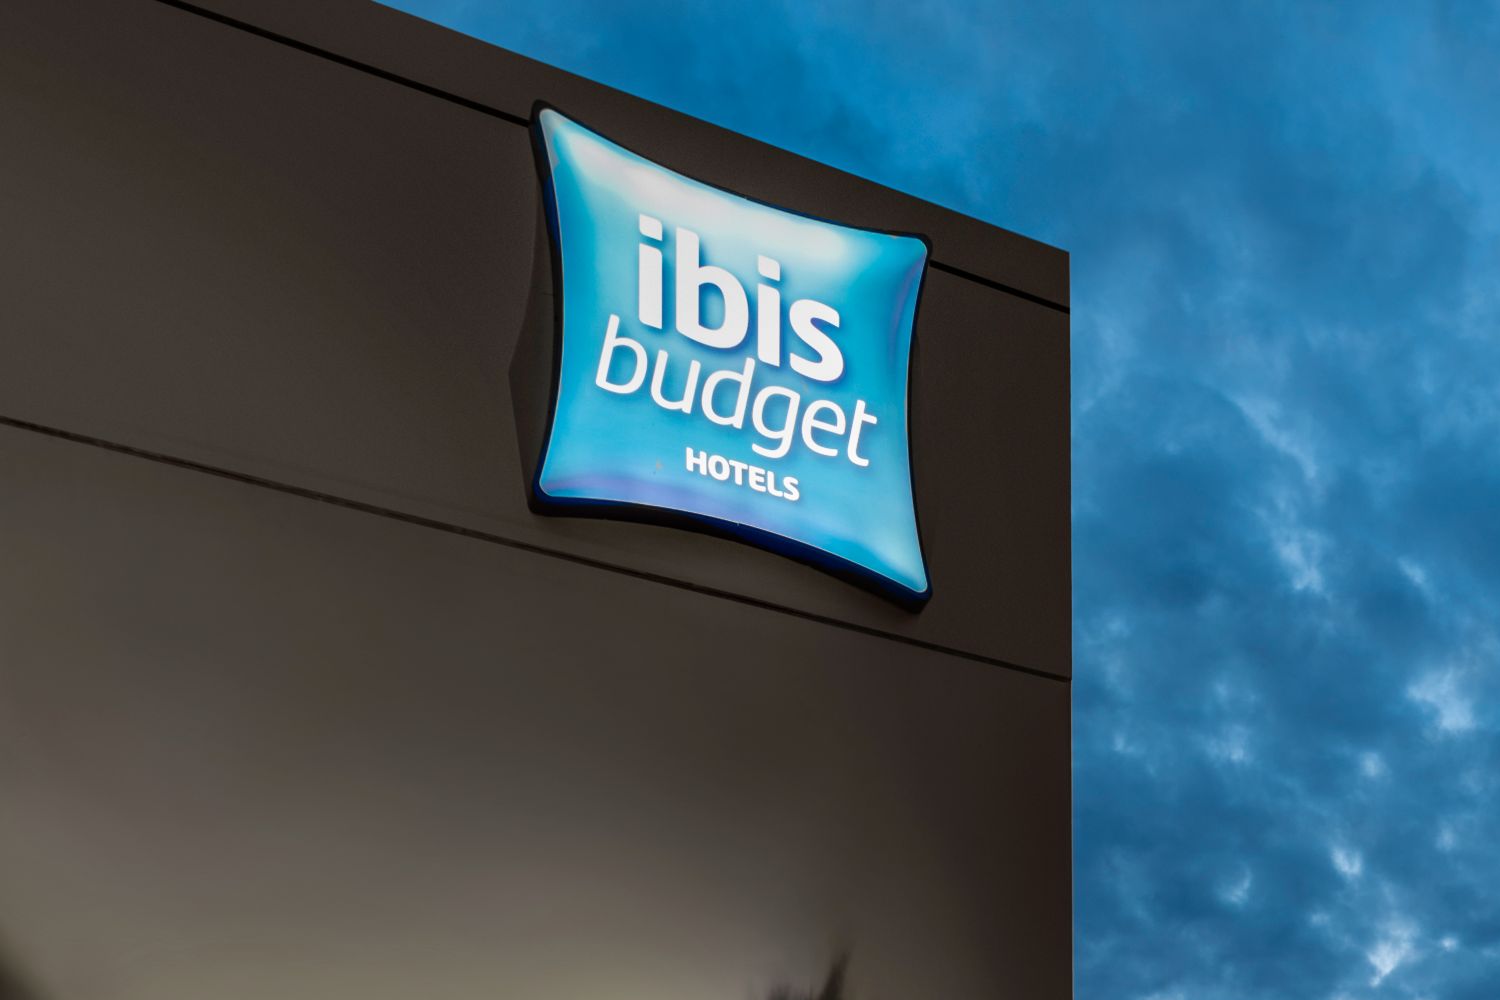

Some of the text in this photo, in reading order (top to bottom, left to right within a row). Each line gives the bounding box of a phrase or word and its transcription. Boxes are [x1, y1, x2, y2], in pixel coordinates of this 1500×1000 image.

[639, 214, 844, 382] ibis
[595, 314, 877, 468] budget
[685, 447, 800, 501] HOTELS
